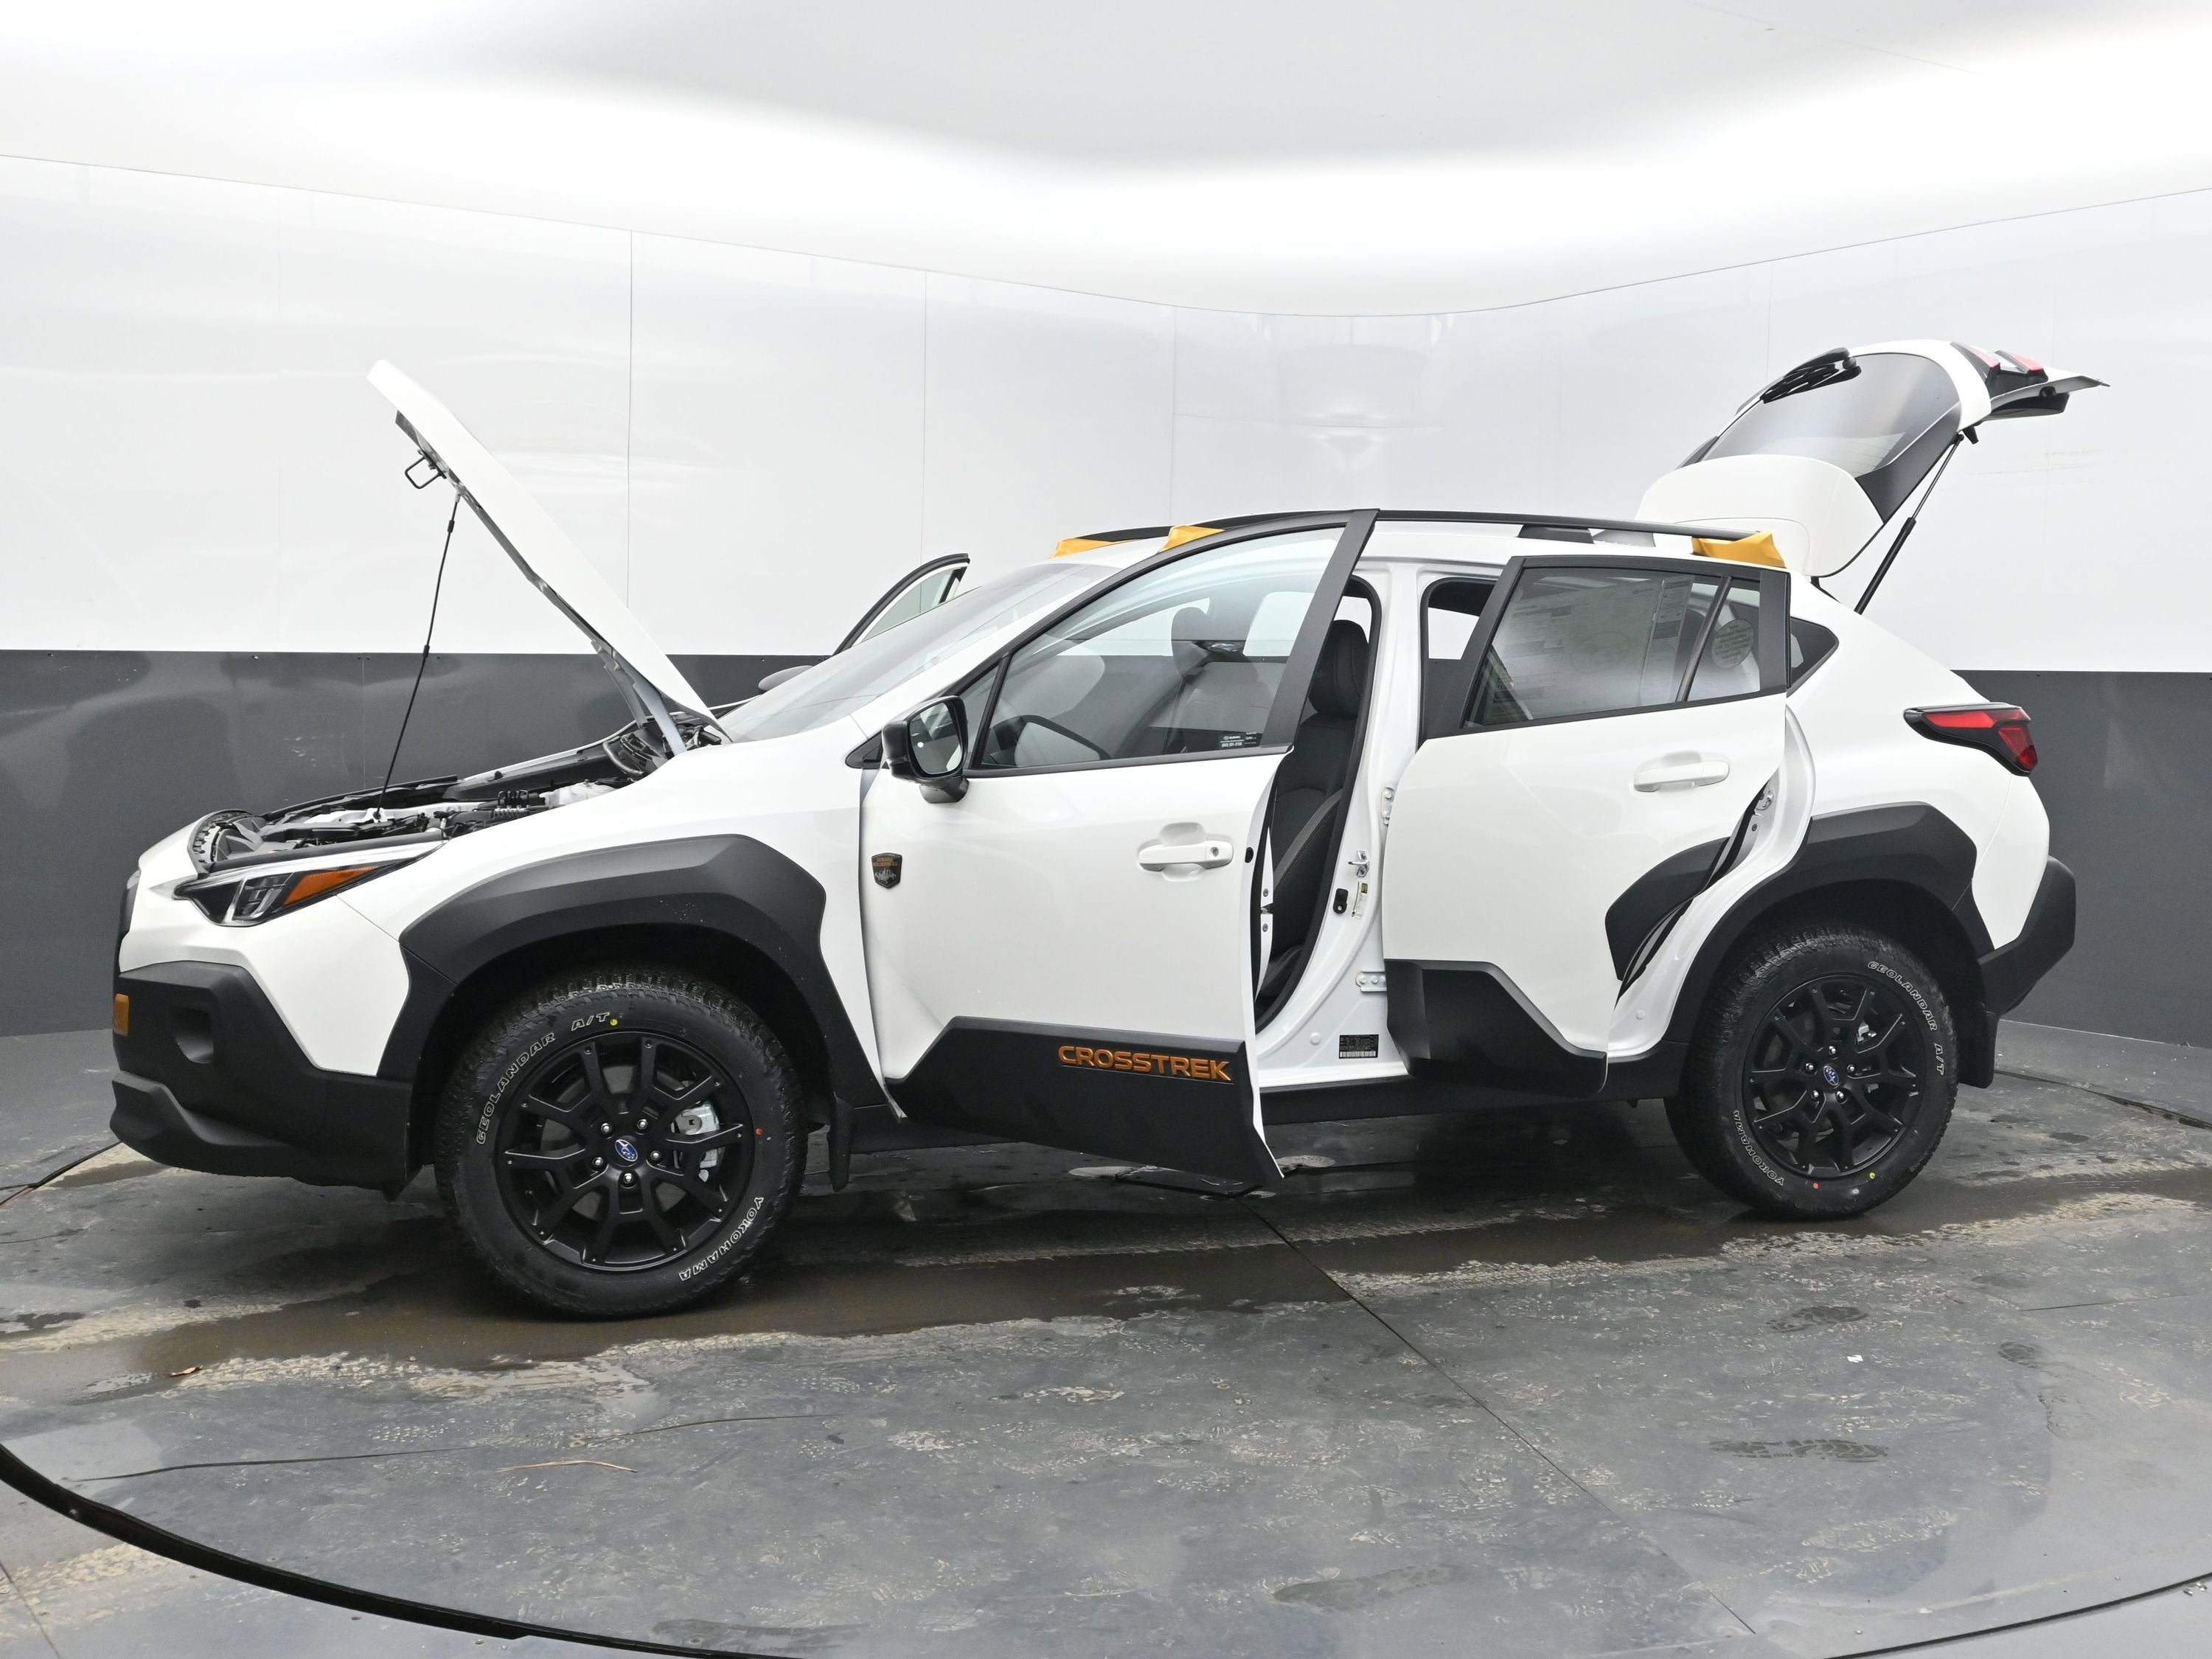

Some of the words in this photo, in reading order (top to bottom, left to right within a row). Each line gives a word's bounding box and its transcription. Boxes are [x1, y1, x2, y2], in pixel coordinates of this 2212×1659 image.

[1868, 961, 1938, 1031] GEOLANDAR
[1934, 1043, 1944, 1075] A/T
[476, 1032, 555, 1144] GEOLANDAR
[571, 1012, 610, 1031] A/T
[1058, 1046, 1231, 1081] CROSSTREK
[1733, 1110, 1784, 1186] YOKOHAMA
[678, 1197, 764, 1281] YOKOHAMA
